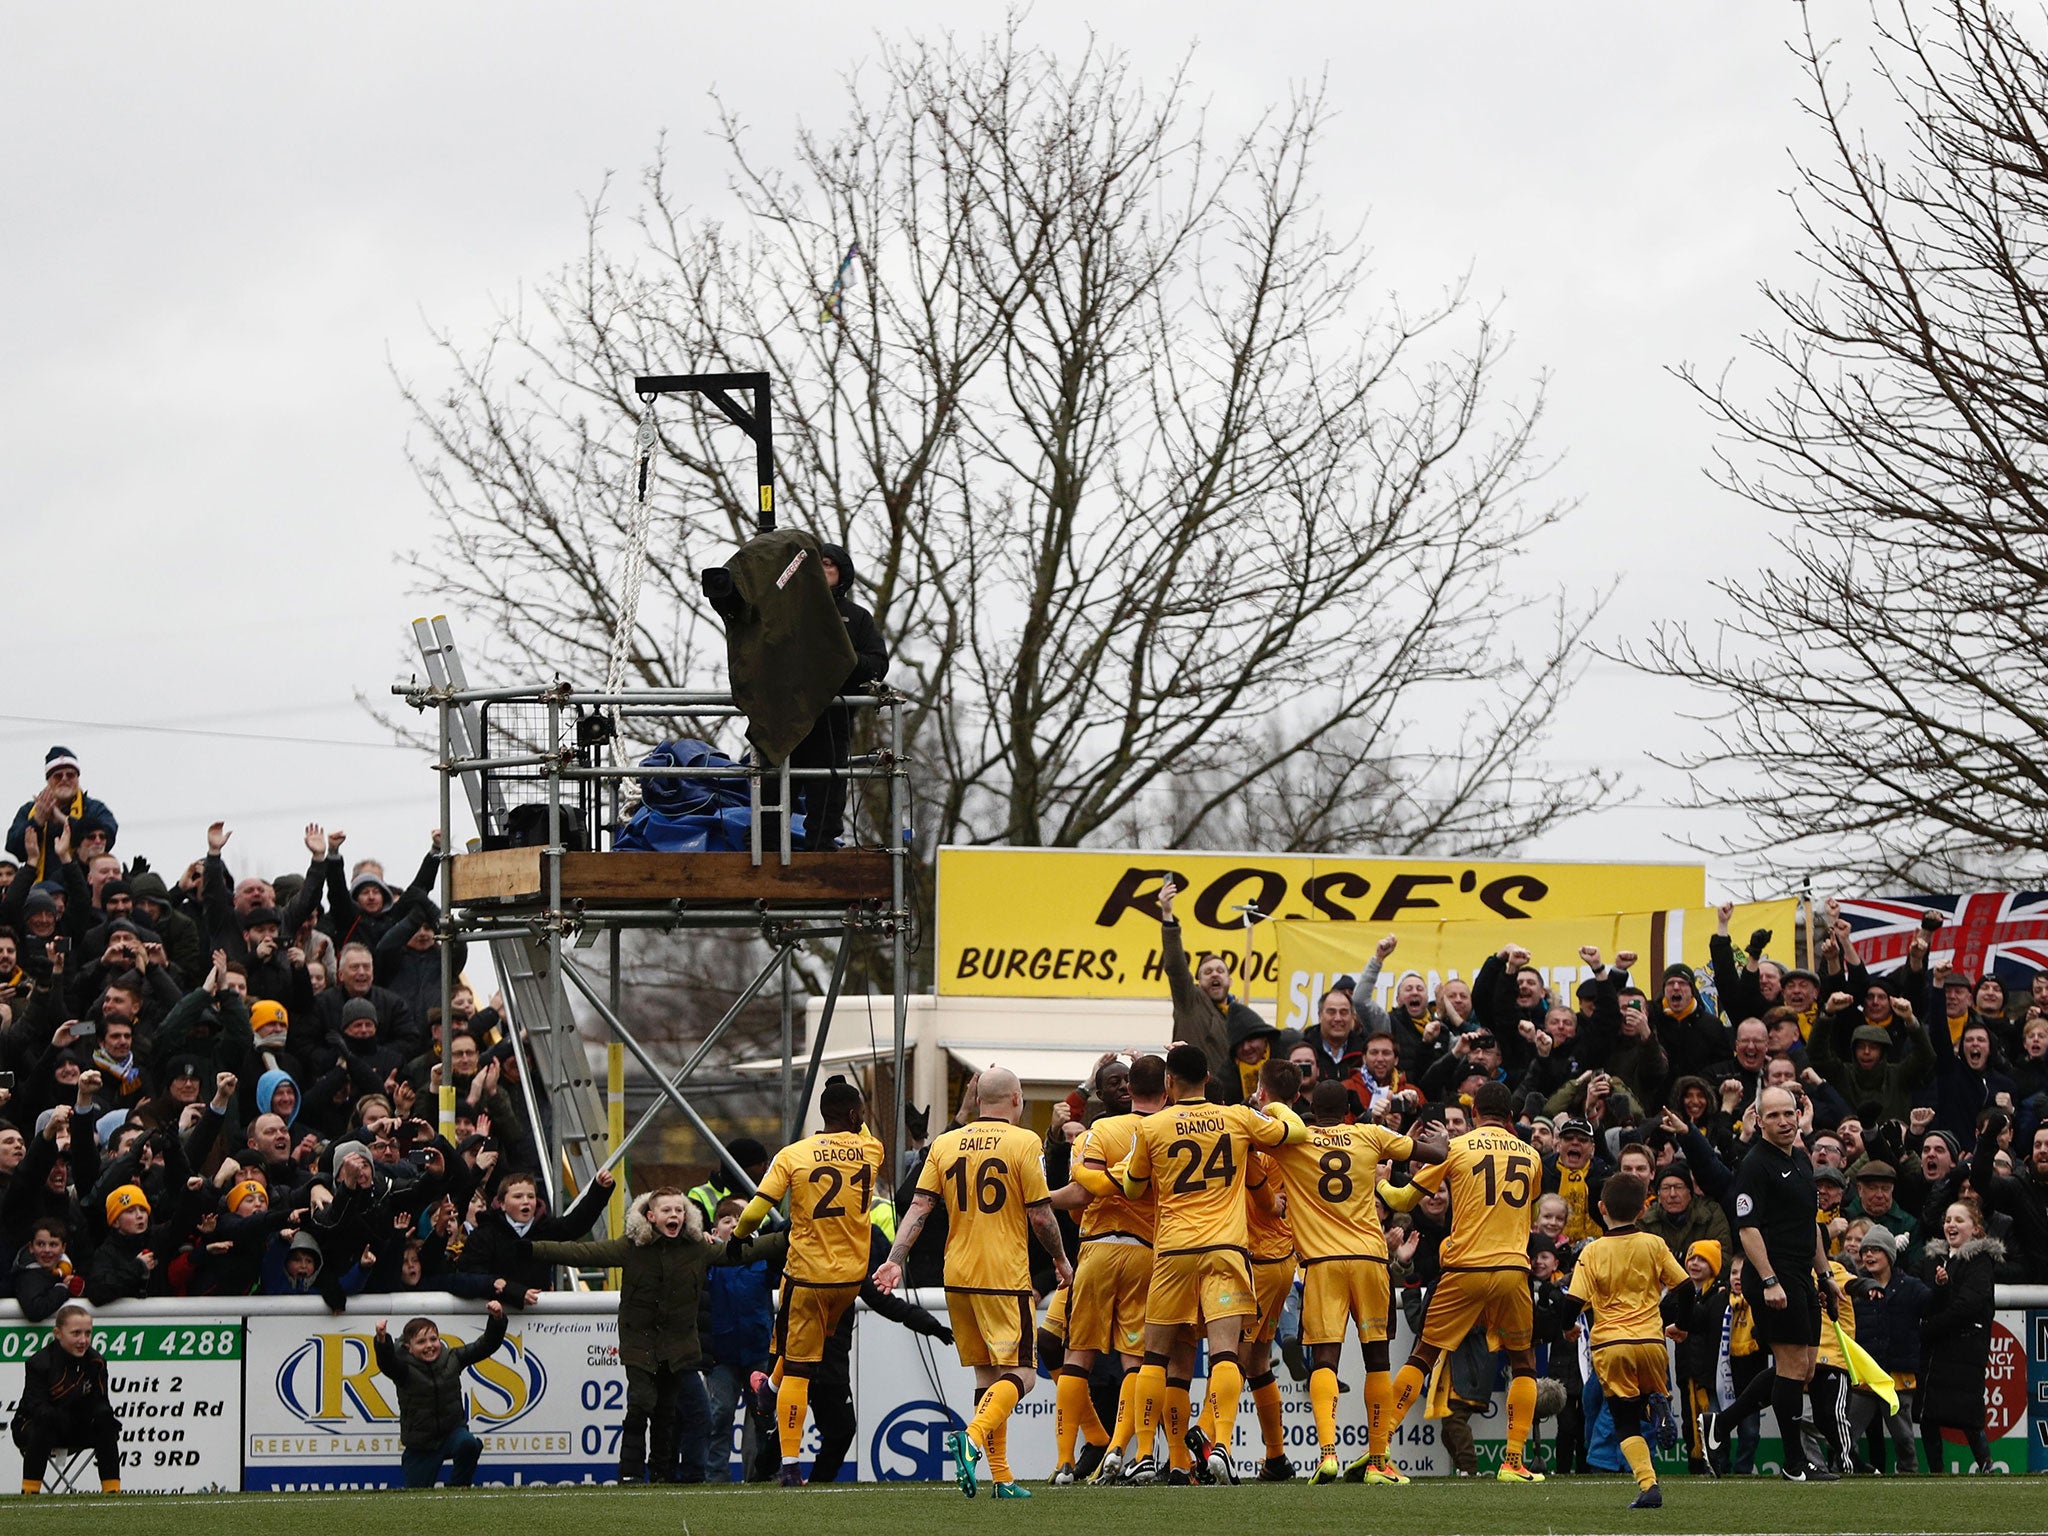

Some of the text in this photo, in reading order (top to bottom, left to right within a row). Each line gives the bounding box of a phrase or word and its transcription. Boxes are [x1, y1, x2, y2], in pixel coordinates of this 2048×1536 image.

[1095, 868, 1548, 930] ROSE'S
[957, 948, 1125, 983] BURGERS,
[1222, 949, 1278, 982] DOG
[1175, 1118, 1225, 1136] BIAMOU
[959, 1137, 1001, 1151] BAILEY
[1313, 1133, 1352, 1147] GOMIS
[1468, 1139, 1531, 1156] EASTMOND
[813, 1148, 864, 1163] DEACON
[1167, 1133, 1237, 1195] 24
[946, 1157, 1008, 1214] 16
[1318, 1150, 1352, 1203] 8
[1472, 1154, 1531, 1208] 15
[808, 1164, 871, 1220] 21
[92, 1331, 145, 1357] 641
[159, 1330, 235, 1356] 4288
[587, 1357, 618, 1367] Guilds
[111, 1377, 183, 1393] Unit 2
[581, 1380, 625, 1411] 02
[193, 1401, 224, 1417] Rd
[1143, 1398, 1153, 1426] SUFC
[1170, 1406, 1178, 1435] SUFC
[254, 1436, 568, 1452] REEVE PLASTE ERVICES
[1394, 1424, 1436, 1446] 148
[154, 1450, 200, 1467] 9RD
